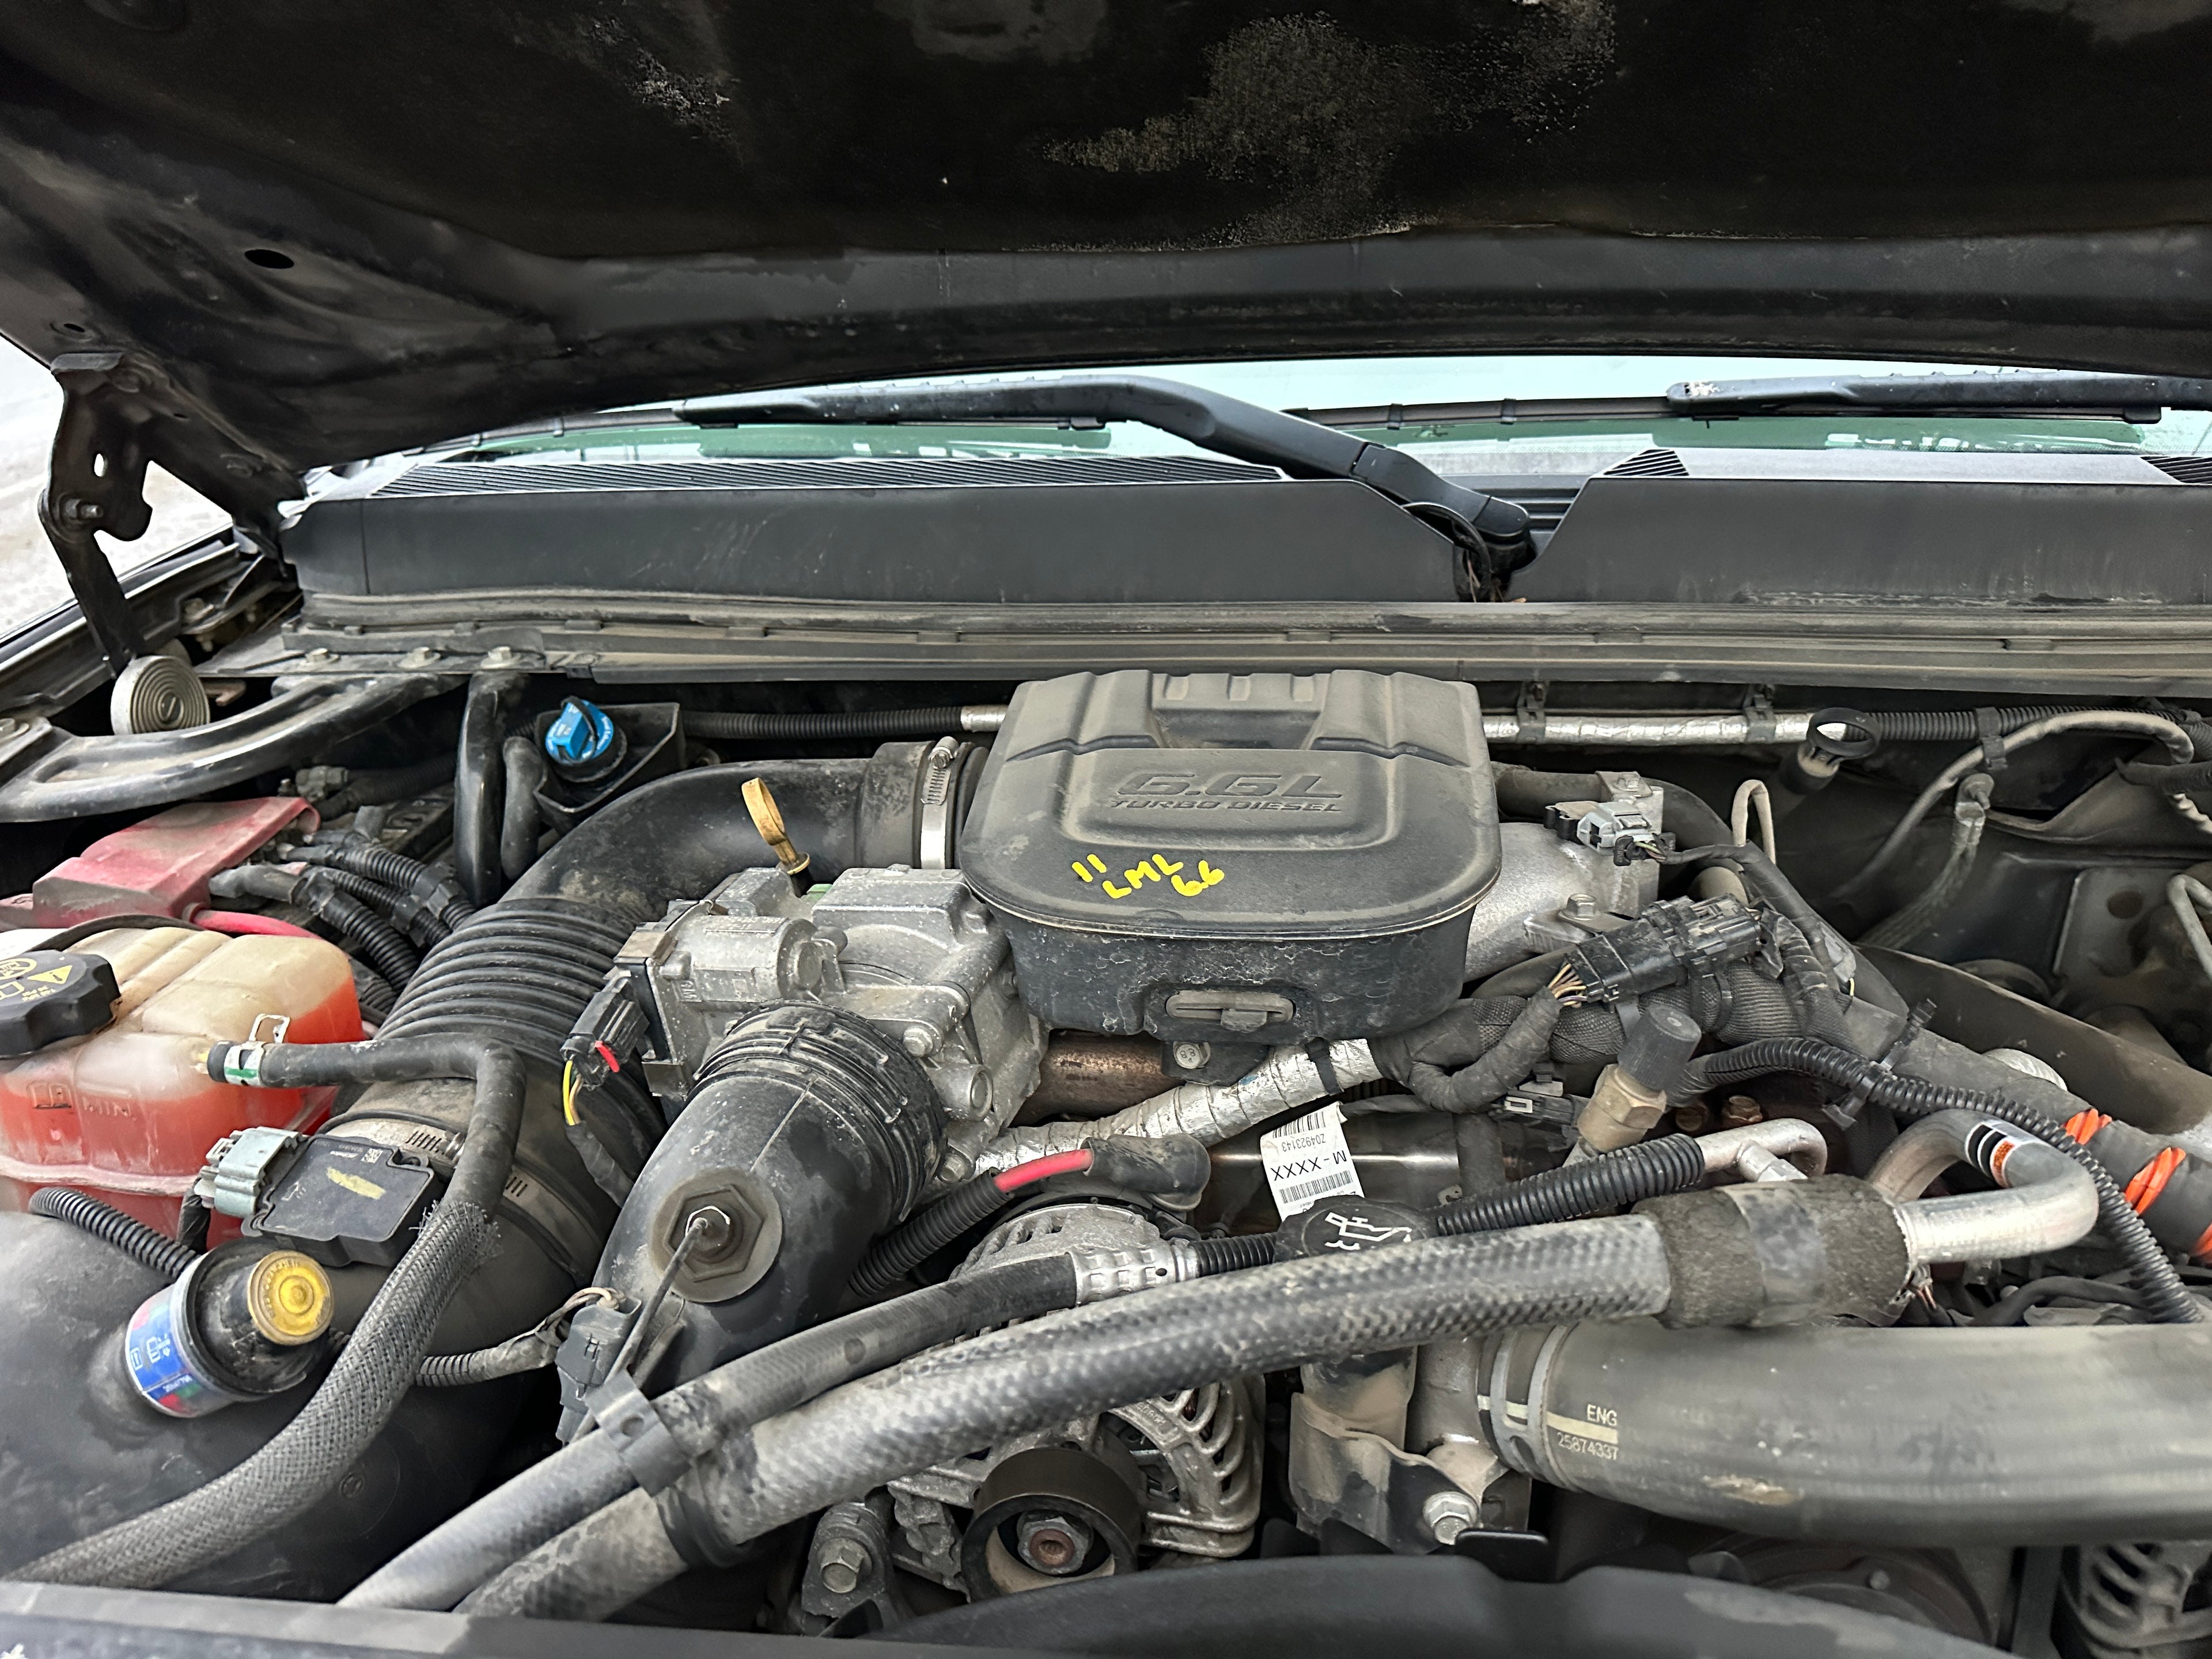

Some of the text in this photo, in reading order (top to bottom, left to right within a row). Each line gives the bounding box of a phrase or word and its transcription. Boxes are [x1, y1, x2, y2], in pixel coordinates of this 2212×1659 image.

[1117, 772, 1343, 799] 6.6L
[1111, 799, 1343, 812] TURBO DIESEL
[1102, 854, 1184, 899] LML
[1281, 1134, 1325, 1152] Z04923143
[1586, 1404, 1618, 1427] ENG
[1556, 1431, 1619, 1461] 25874337
